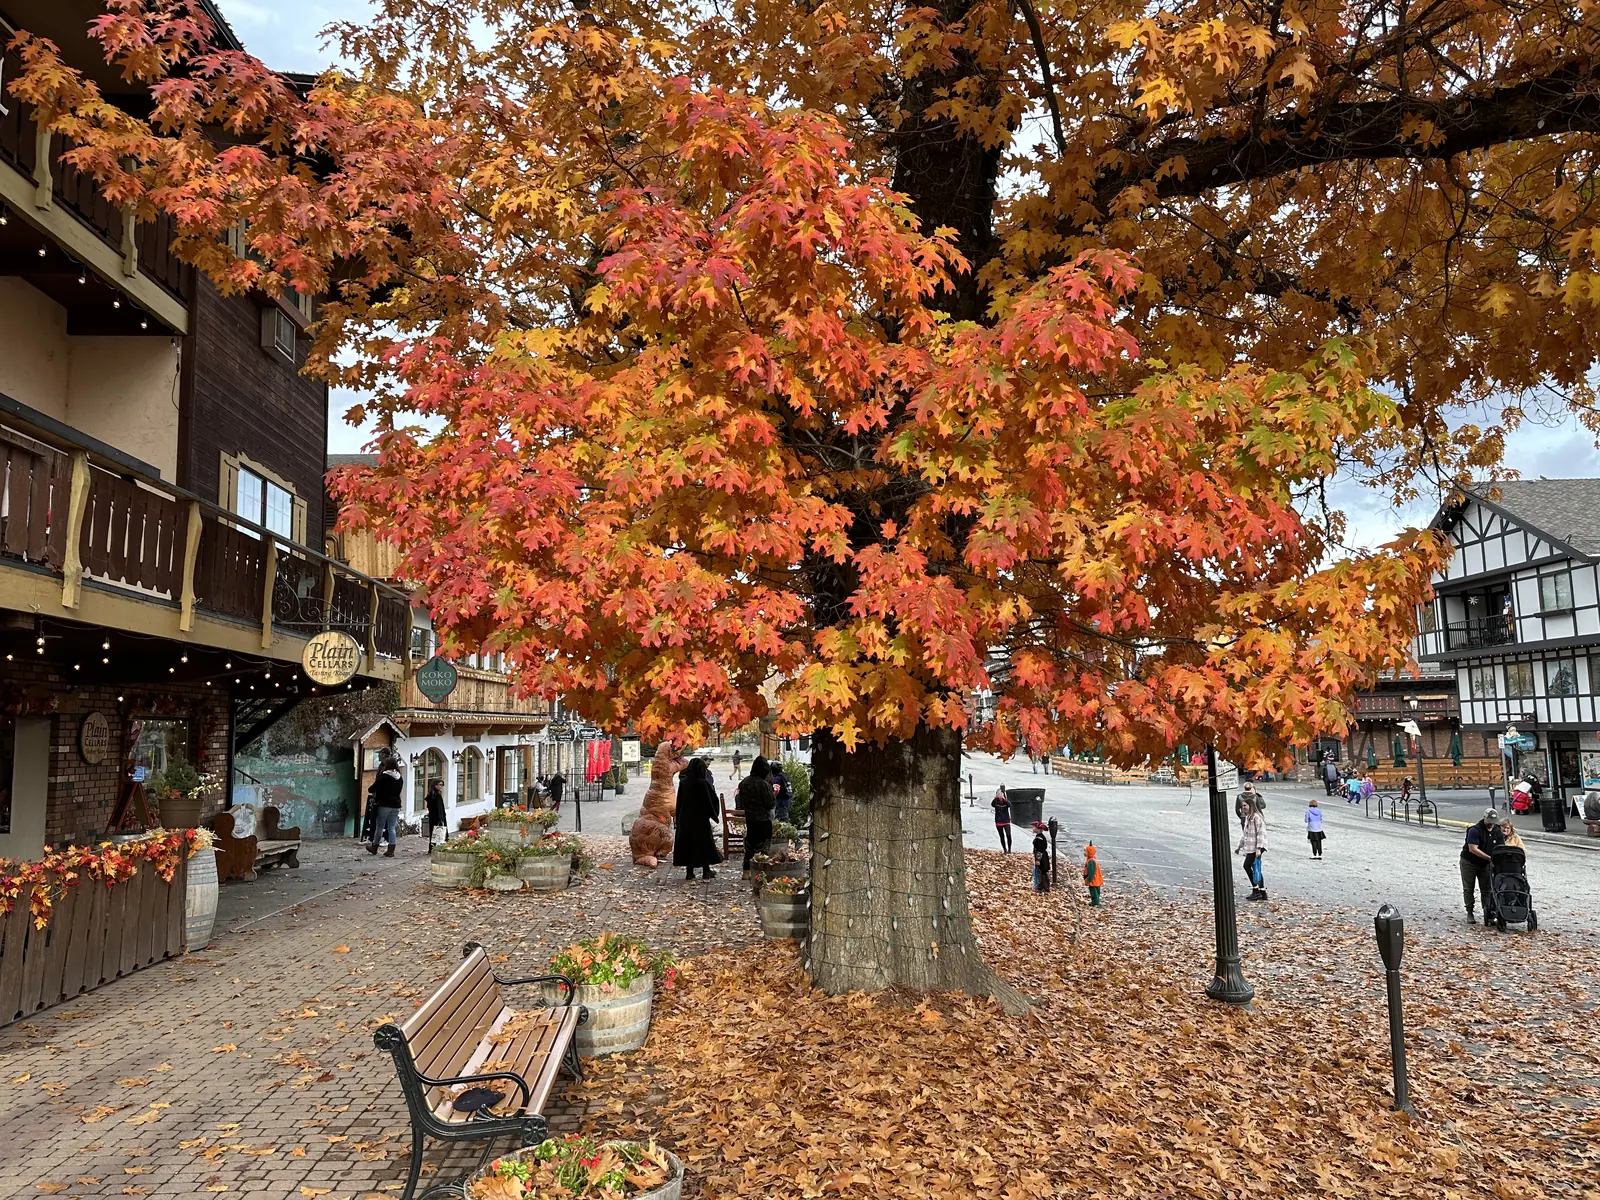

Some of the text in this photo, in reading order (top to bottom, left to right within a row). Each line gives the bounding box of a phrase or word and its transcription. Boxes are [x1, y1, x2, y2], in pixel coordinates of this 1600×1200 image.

[310, 640, 354, 660] Plain
[310, 659, 354, 668] CELLARS
[85, 720, 108, 737] Plain
[84, 738, 106, 746] CELLARS
